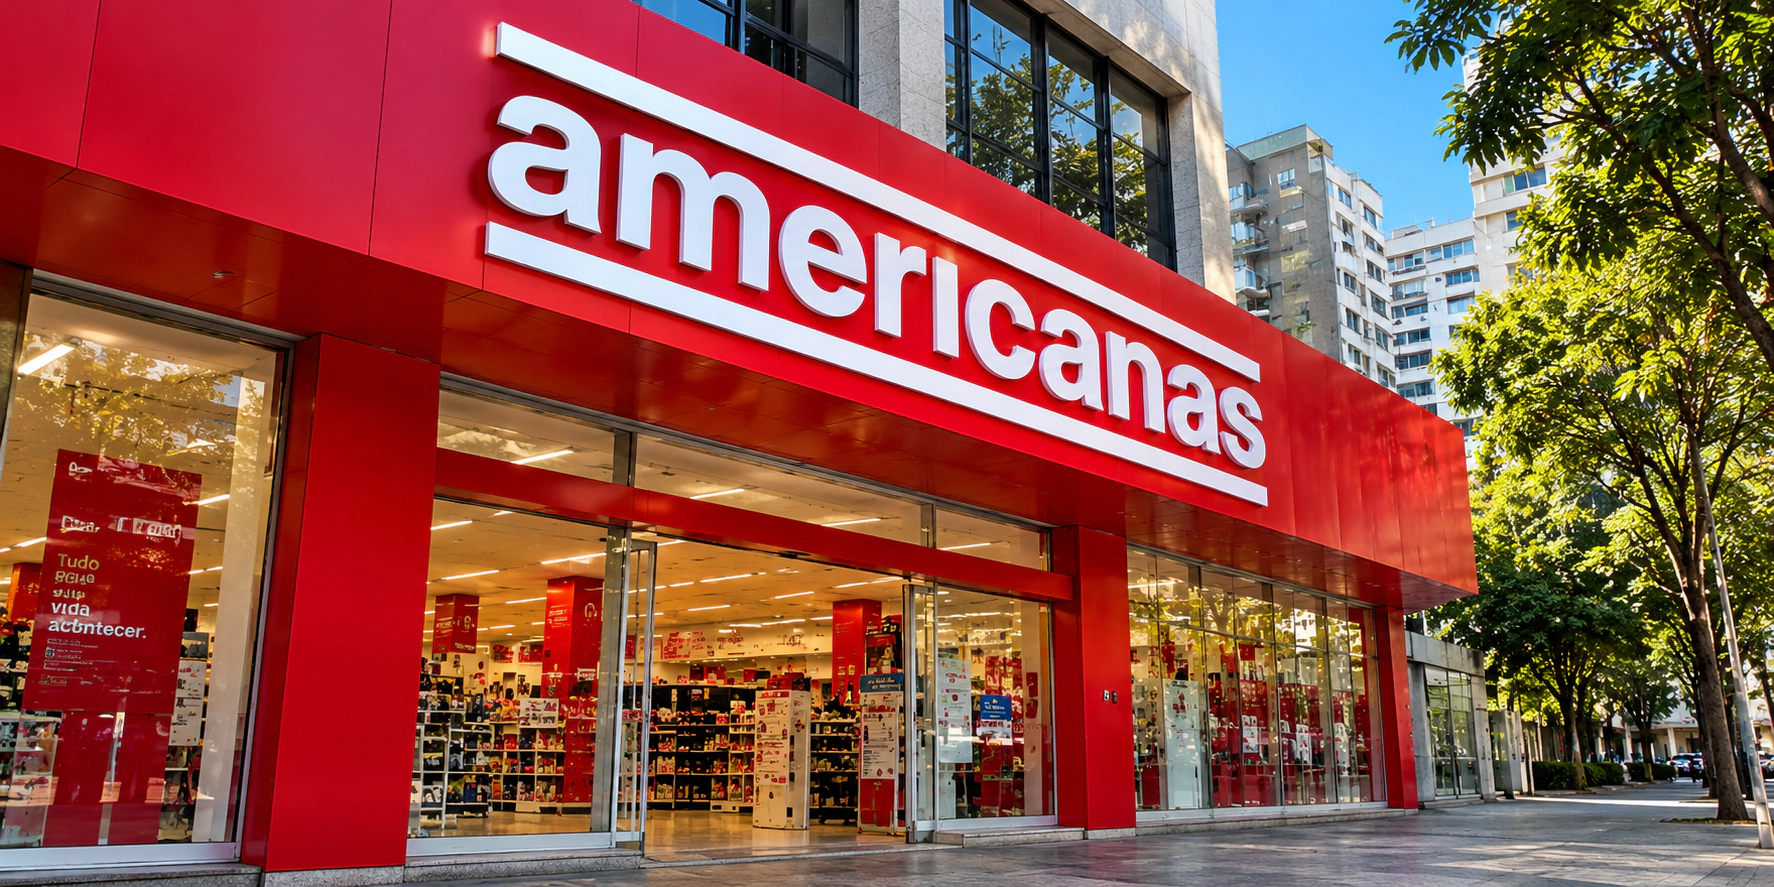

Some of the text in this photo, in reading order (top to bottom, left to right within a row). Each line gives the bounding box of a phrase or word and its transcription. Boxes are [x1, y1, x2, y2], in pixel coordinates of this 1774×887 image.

[487, 95, 1267, 469] americanas
[57, 553, 100, 571] Tudo
[51, 602, 90, 617] vida
